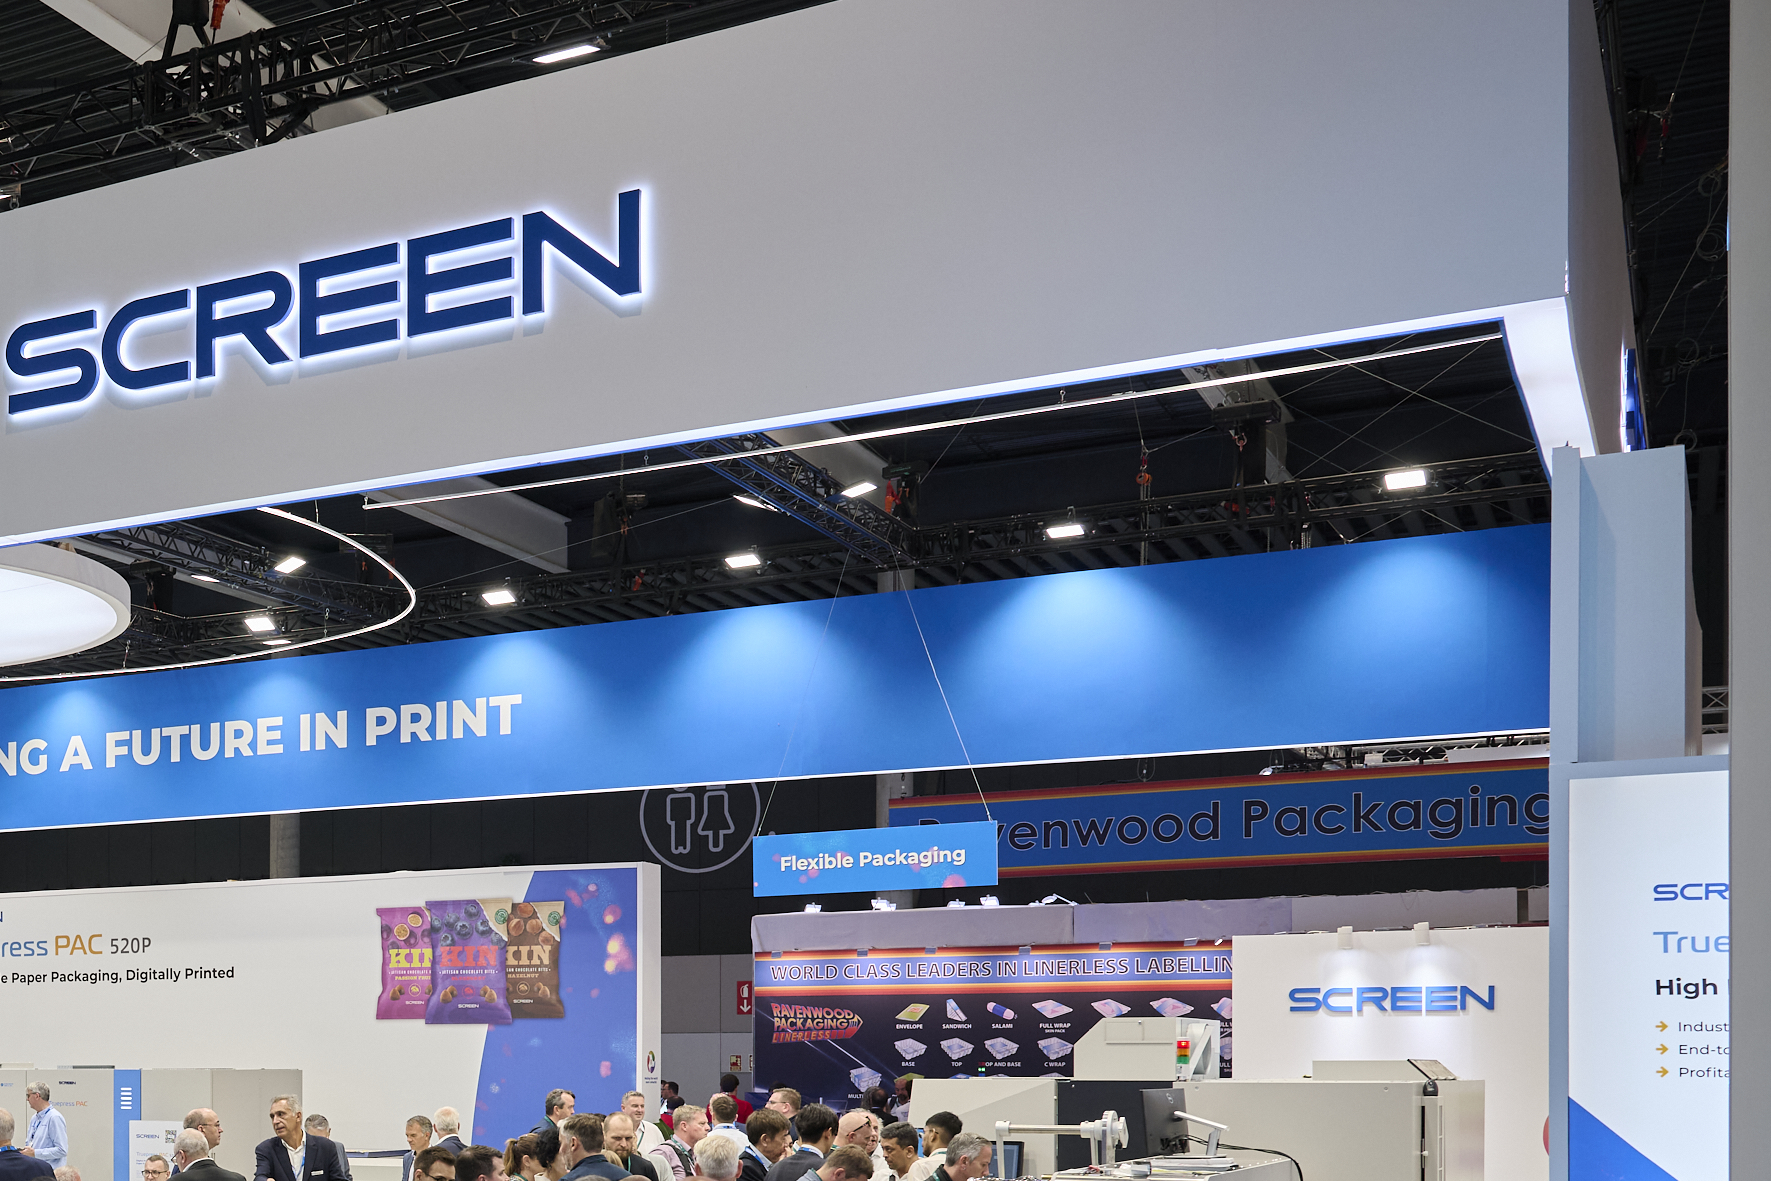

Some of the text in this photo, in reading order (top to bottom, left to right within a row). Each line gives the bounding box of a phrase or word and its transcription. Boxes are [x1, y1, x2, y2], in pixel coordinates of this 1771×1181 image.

[5, 188, 642, 416] SCREEN
[61, 732, 93, 772] A
[106, 715, 284, 768] FUTURE
[300, 708, 348, 753] IN
[364, 694, 523, 747] PRINT
[919, 799, 1221, 852] enwood
[780, 846, 966, 873] Flexible Packaging
[55, 934, 103, 956] PAC
[110, 937, 151, 954] 520P
[440, 945, 498, 967] KIN
[11, 972, 47, 985] Paper
[51, 969, 122, 983] Packaging,
[126, 967, 180, 982] Digitally
[185, 966, 235, 979] Printed
[771, 964, 839, 982] WORLD
[843, 962, 902, 980] CLASS
[906, 960, 992, 978] LEADERS
[997, 959, 1018, 976] IN
[1023, 957, 1130, 976] LINERLESS
[1288, 985, 1495, 1013] SCREEN
[1656, 978, 1718, 999] High
[770, 1003, 854, 1020] RAVENWOOD
[774, 1016, 849, 1031] PACKAGING
[772, 1030, 831, 1043] LINERLESS
